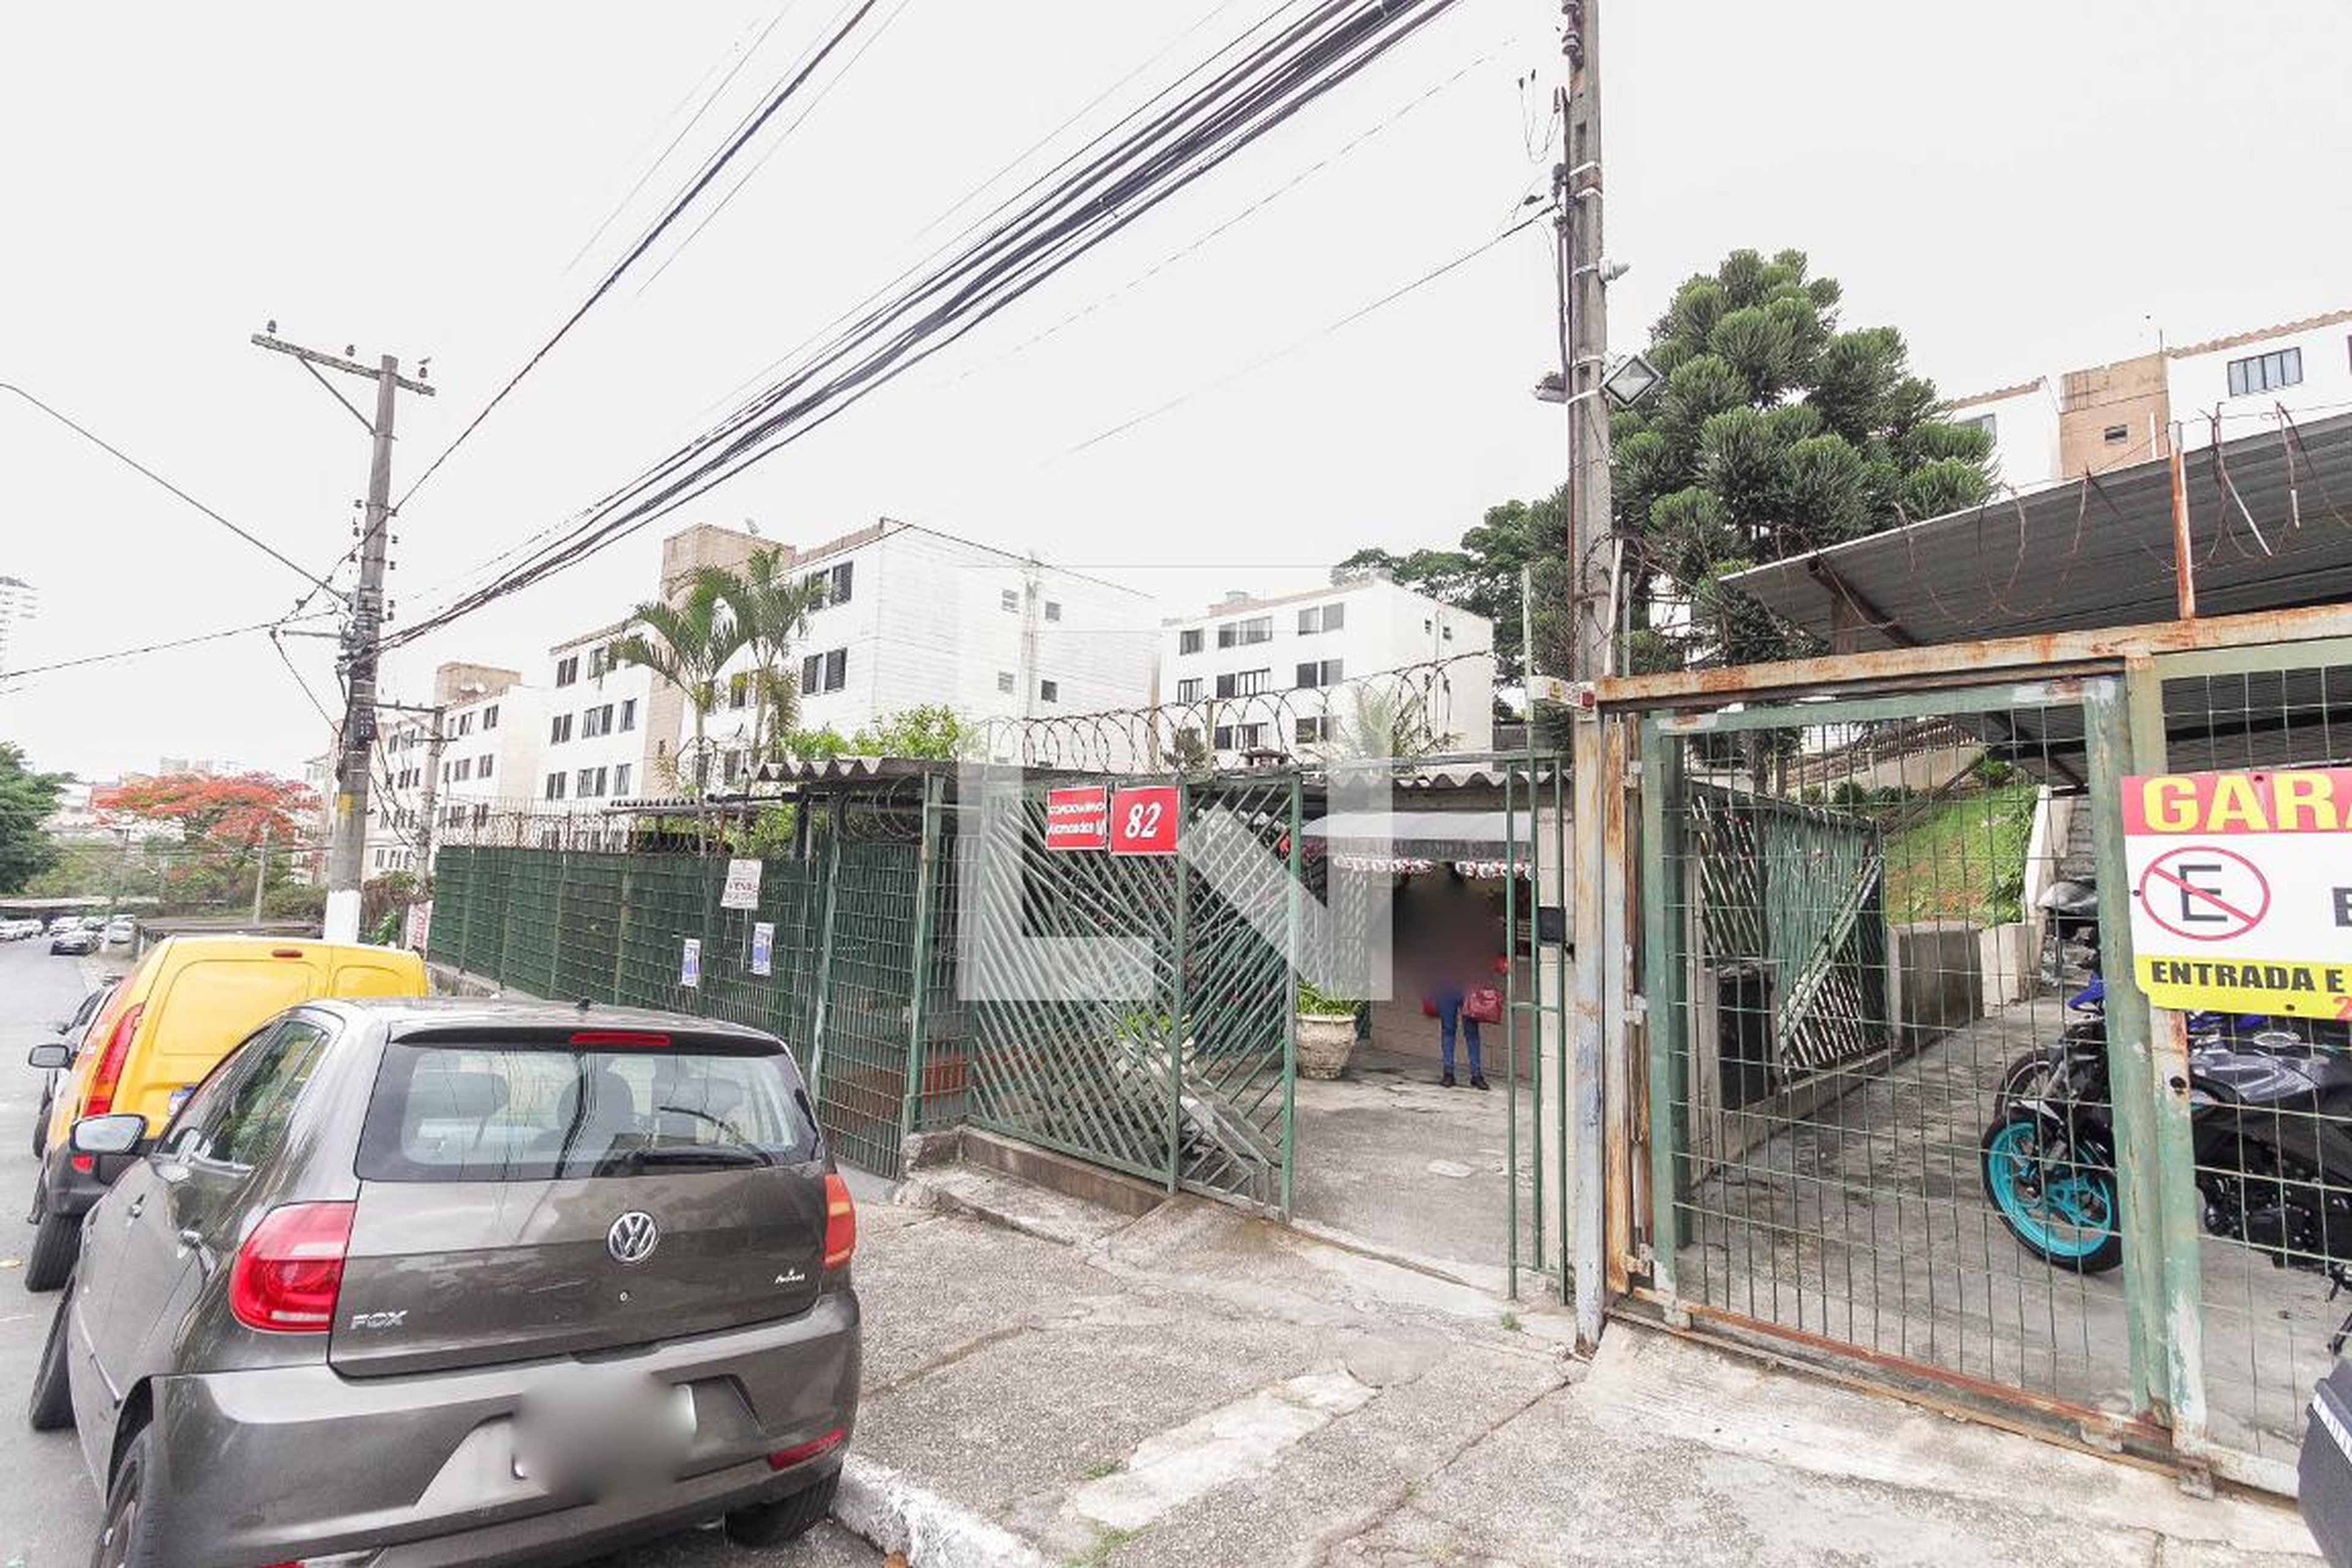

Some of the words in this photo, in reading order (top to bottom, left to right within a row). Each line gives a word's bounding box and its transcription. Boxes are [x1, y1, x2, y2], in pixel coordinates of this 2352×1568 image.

[1125, 802, 1162, 839] 82
[2143, 772, 2352, 832] GAR
[2178, 865, 2228, 921] E
[2151, 962, 2315, 991] ENTRADA
[2325, 969, 2345, 992] E
[351, 1310, 408, 1329] FOX
